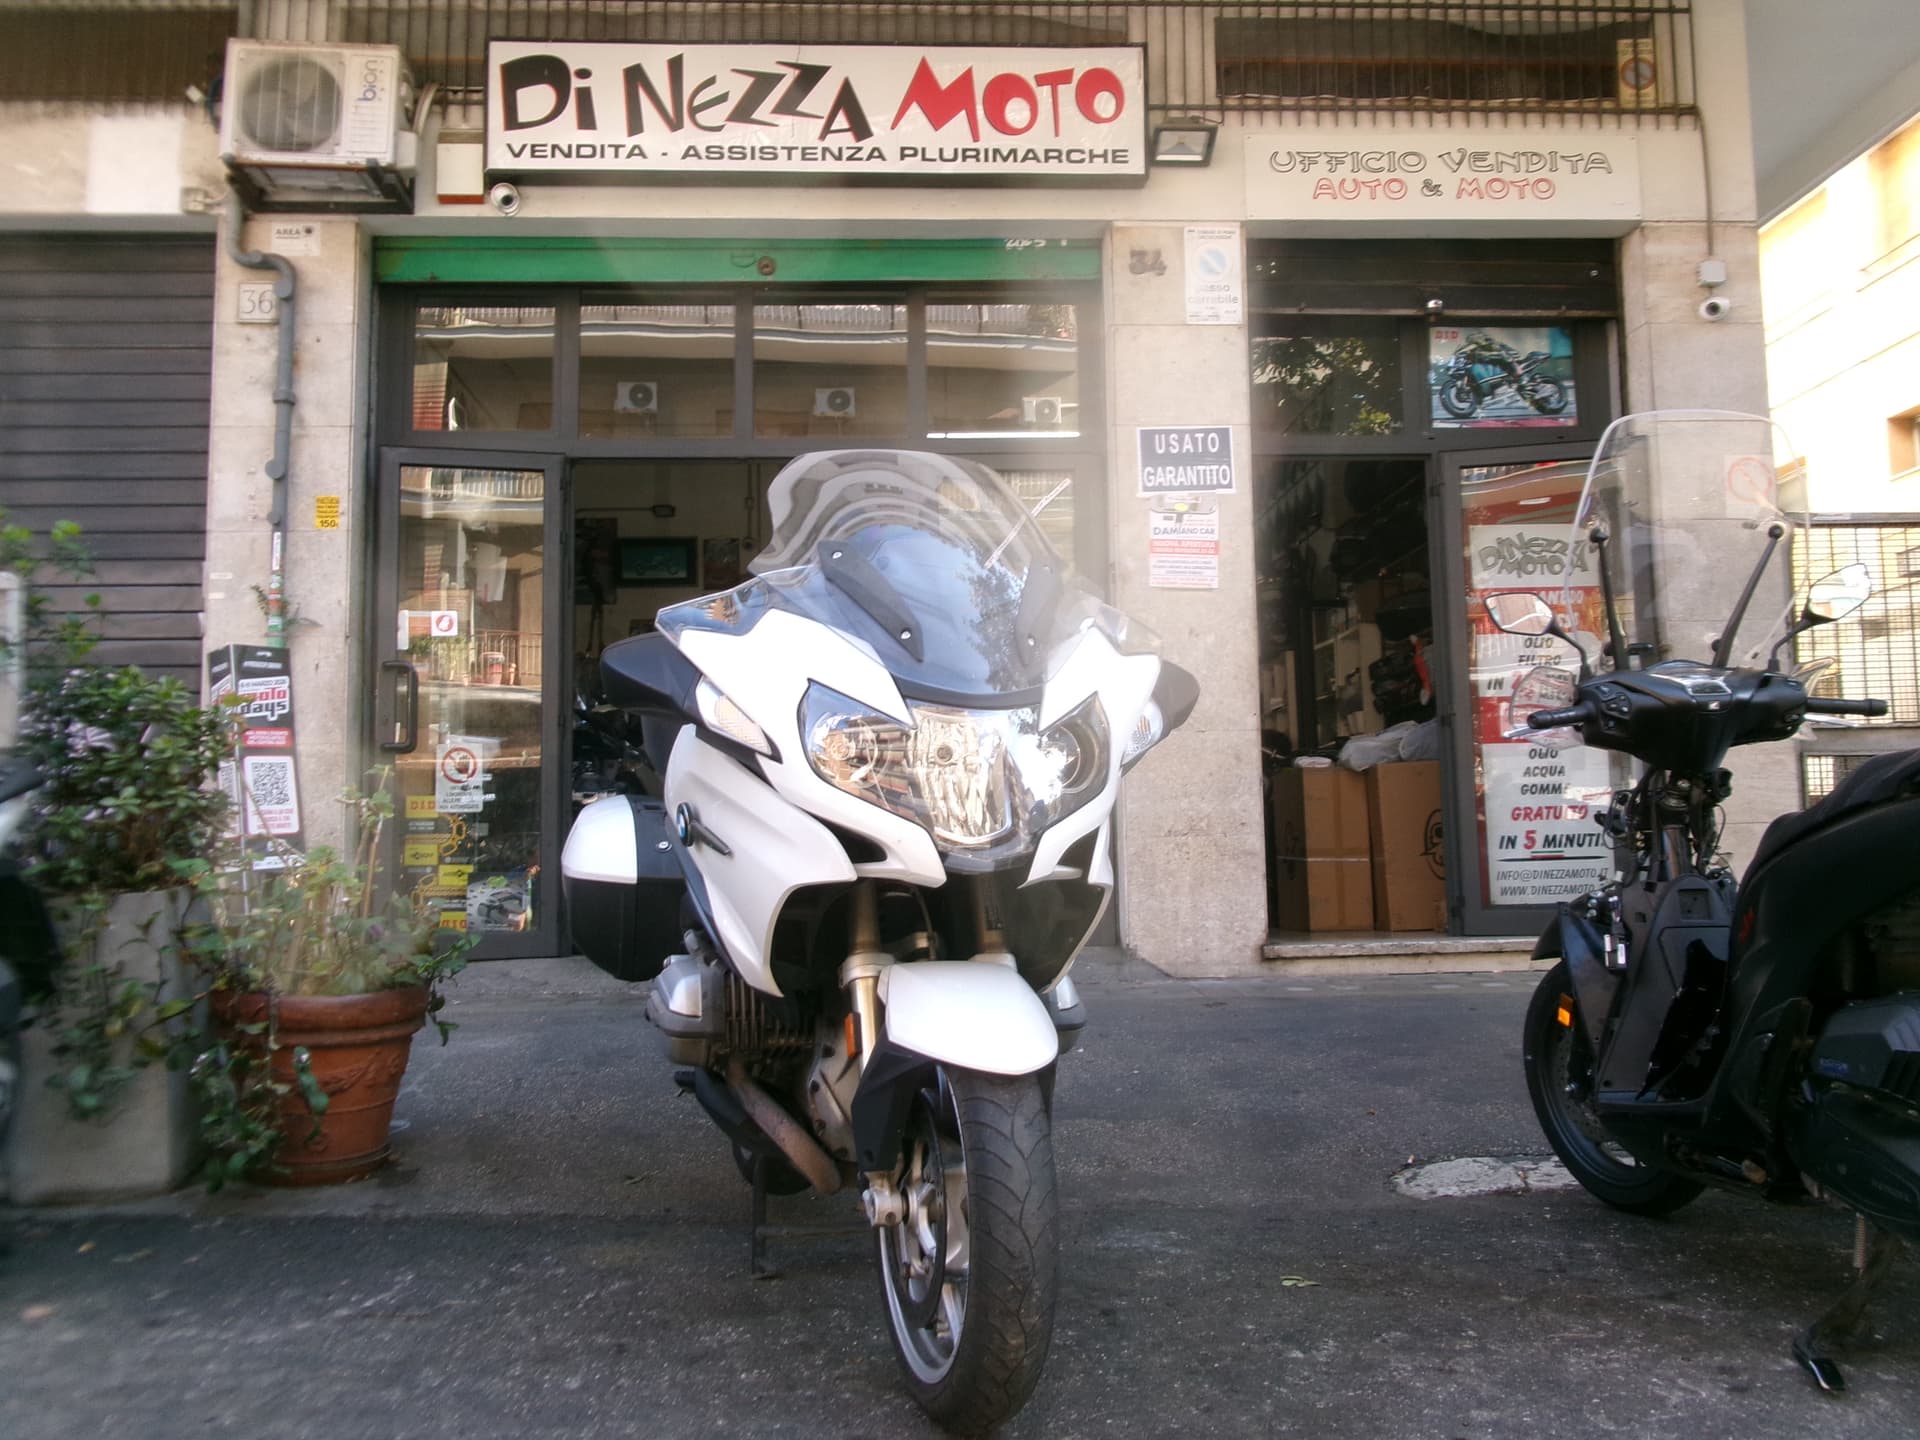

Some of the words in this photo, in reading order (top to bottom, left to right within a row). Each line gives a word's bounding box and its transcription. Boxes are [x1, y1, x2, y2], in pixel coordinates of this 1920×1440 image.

[891, 56, 1125, 142] MOTO
[506, 143, 648, 160] VENDITA
[681, 144, 886, 162] ASSISTENZA
[901, 146, 1129, 164] PLURIMARCHE
[1270, 151, 1427, 174] UFFICIO
[1438, 148, 1613, 174] VENDITA
[1312, 178, 1408, 200] AUTO
[1421, 178, 1443, 197] &
[1456, 178, 1556, 200] MOTO
[1128, 249, 1168, 276] 34
[240, 289, 274, 314] 36
[1155, 432, 1220, 454] USATO
[1143, 464, 1231, 487] GARANTITO
[1524, 637, 1554, 649] OLIO
[1518, 654, 1562, 666] FILTRO
[1487, 678, 1504, 690] IN
[1528, 747, 1559, 759] OLIO
[1523, 765, 1566, 778] ACQUA
[1511, 805, 1589, 822] GRATUTO
[1499, 834, 1517, 849] IN
[1523, 830, 1537, 850] 5
